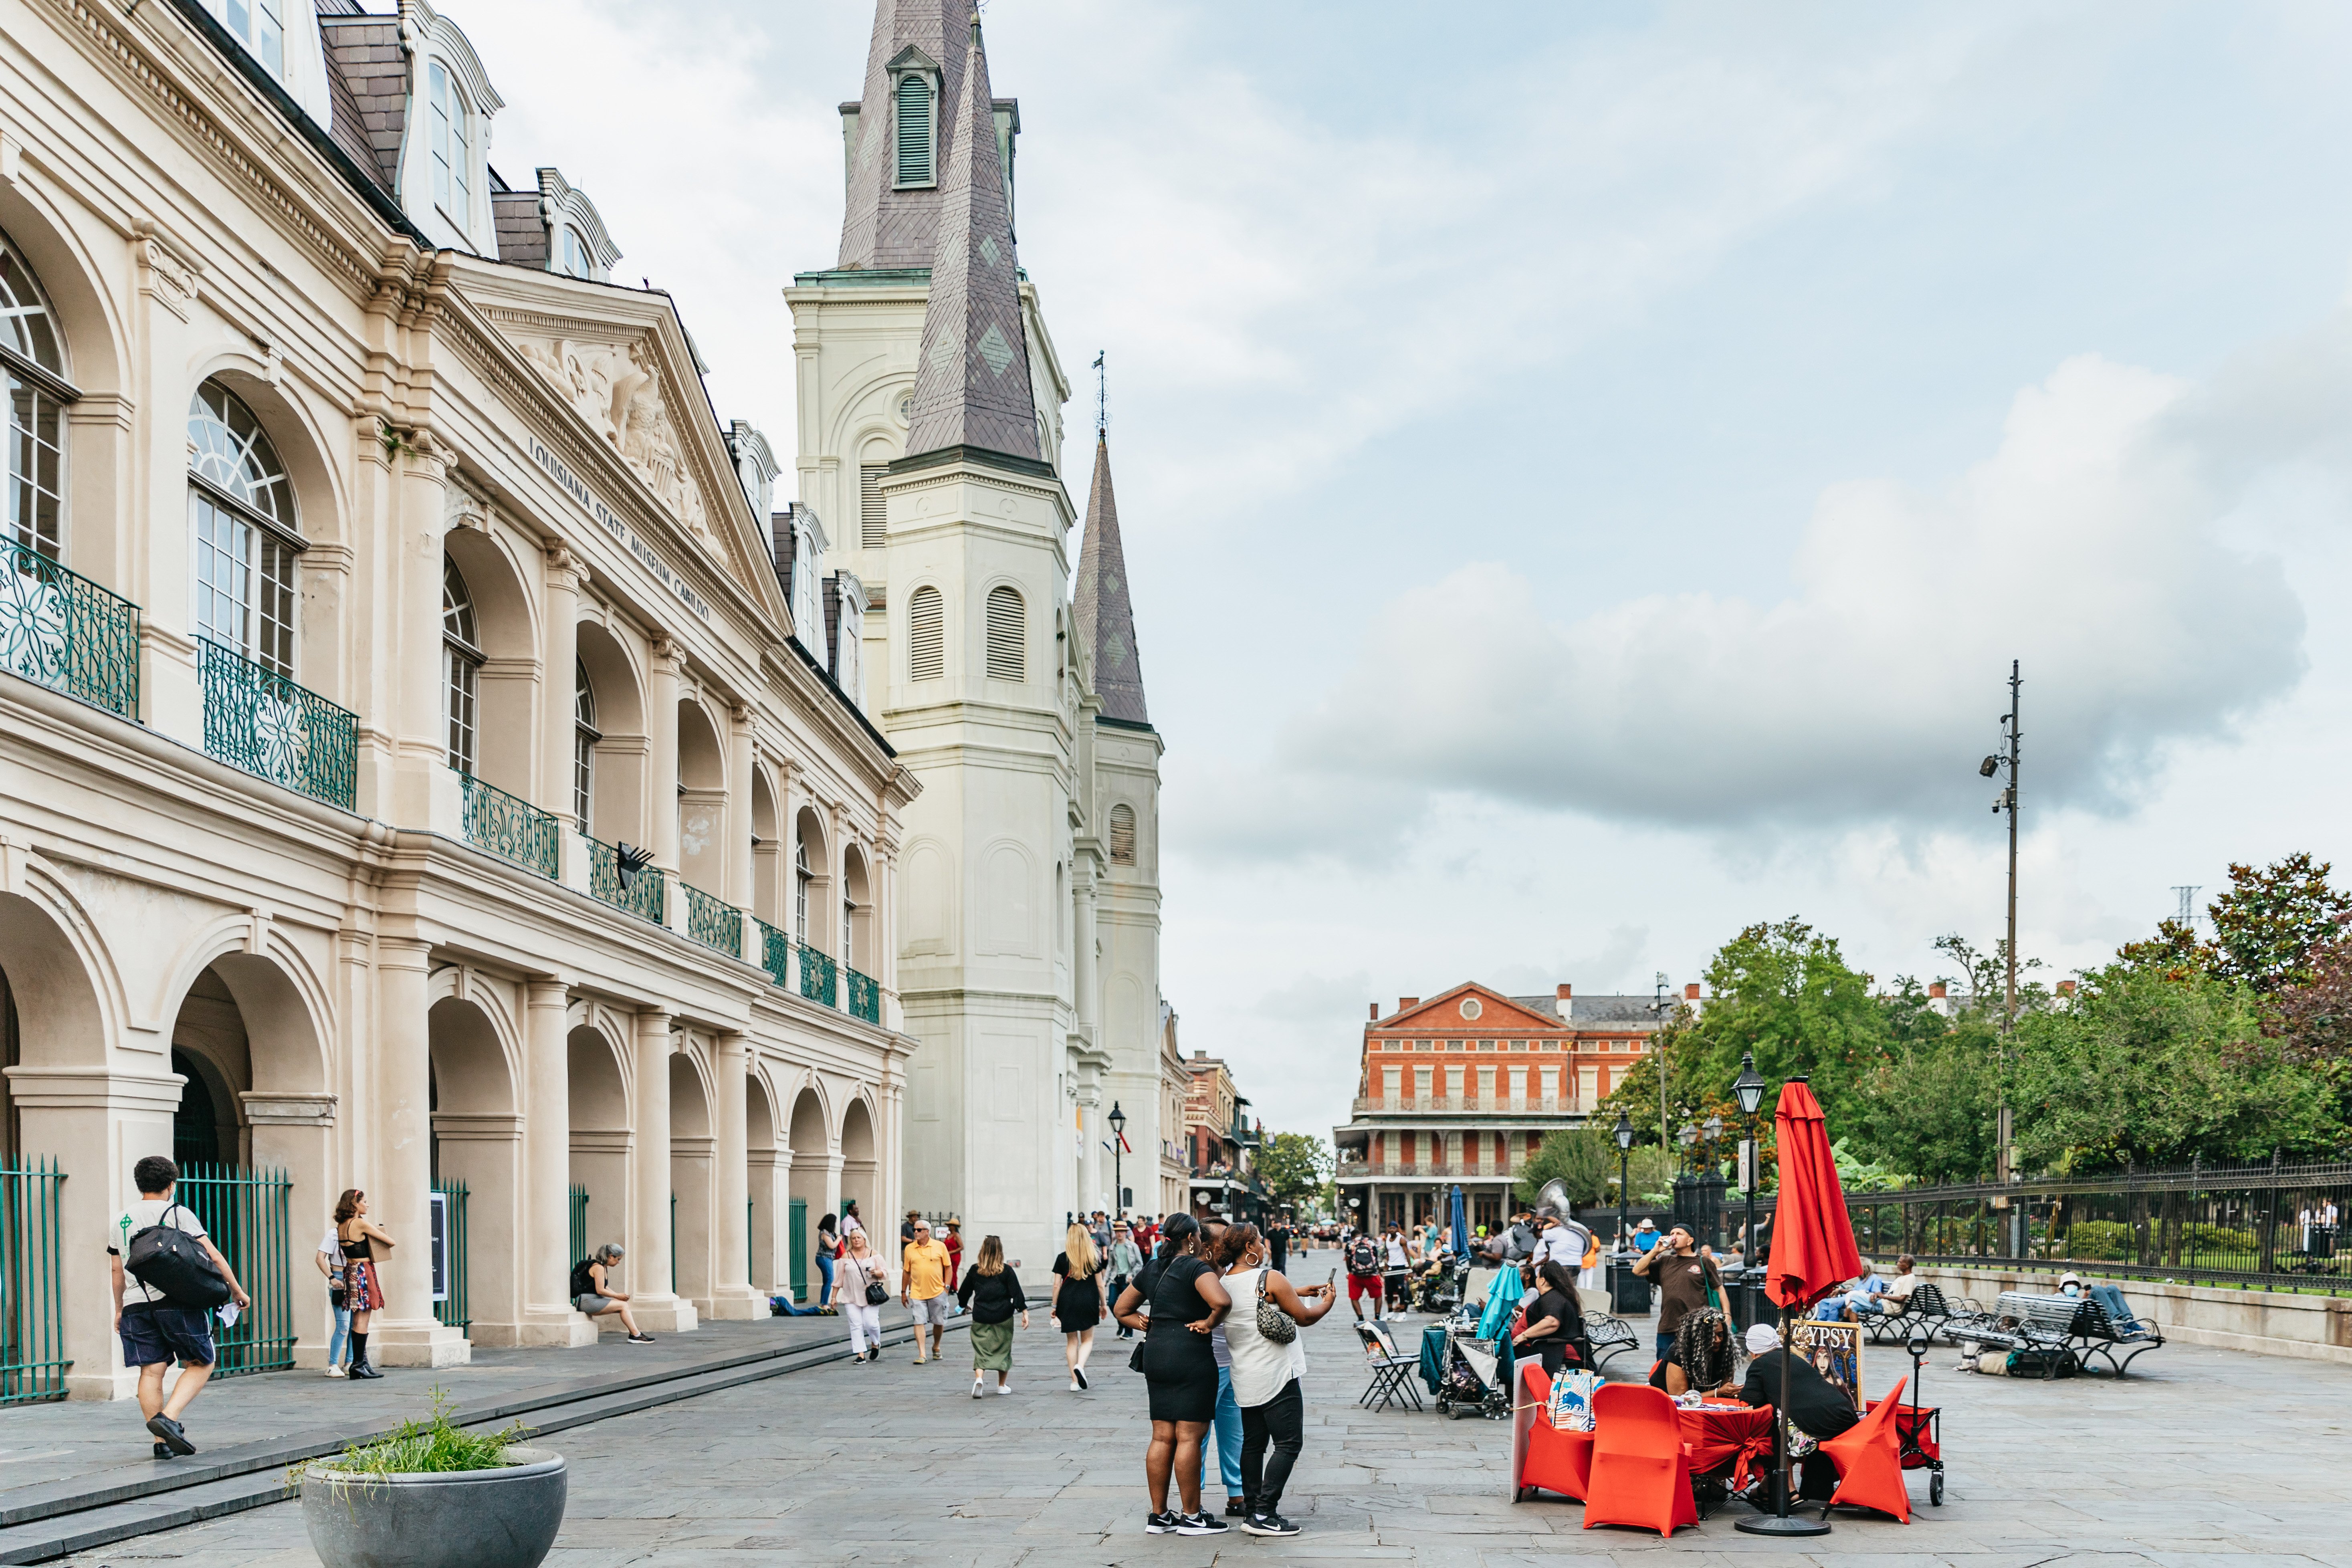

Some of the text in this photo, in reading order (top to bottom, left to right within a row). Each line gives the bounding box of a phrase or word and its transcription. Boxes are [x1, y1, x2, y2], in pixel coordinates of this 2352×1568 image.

[530, 437, 709, 621] LOUISIANA STATE MUSEUM CABILDO
